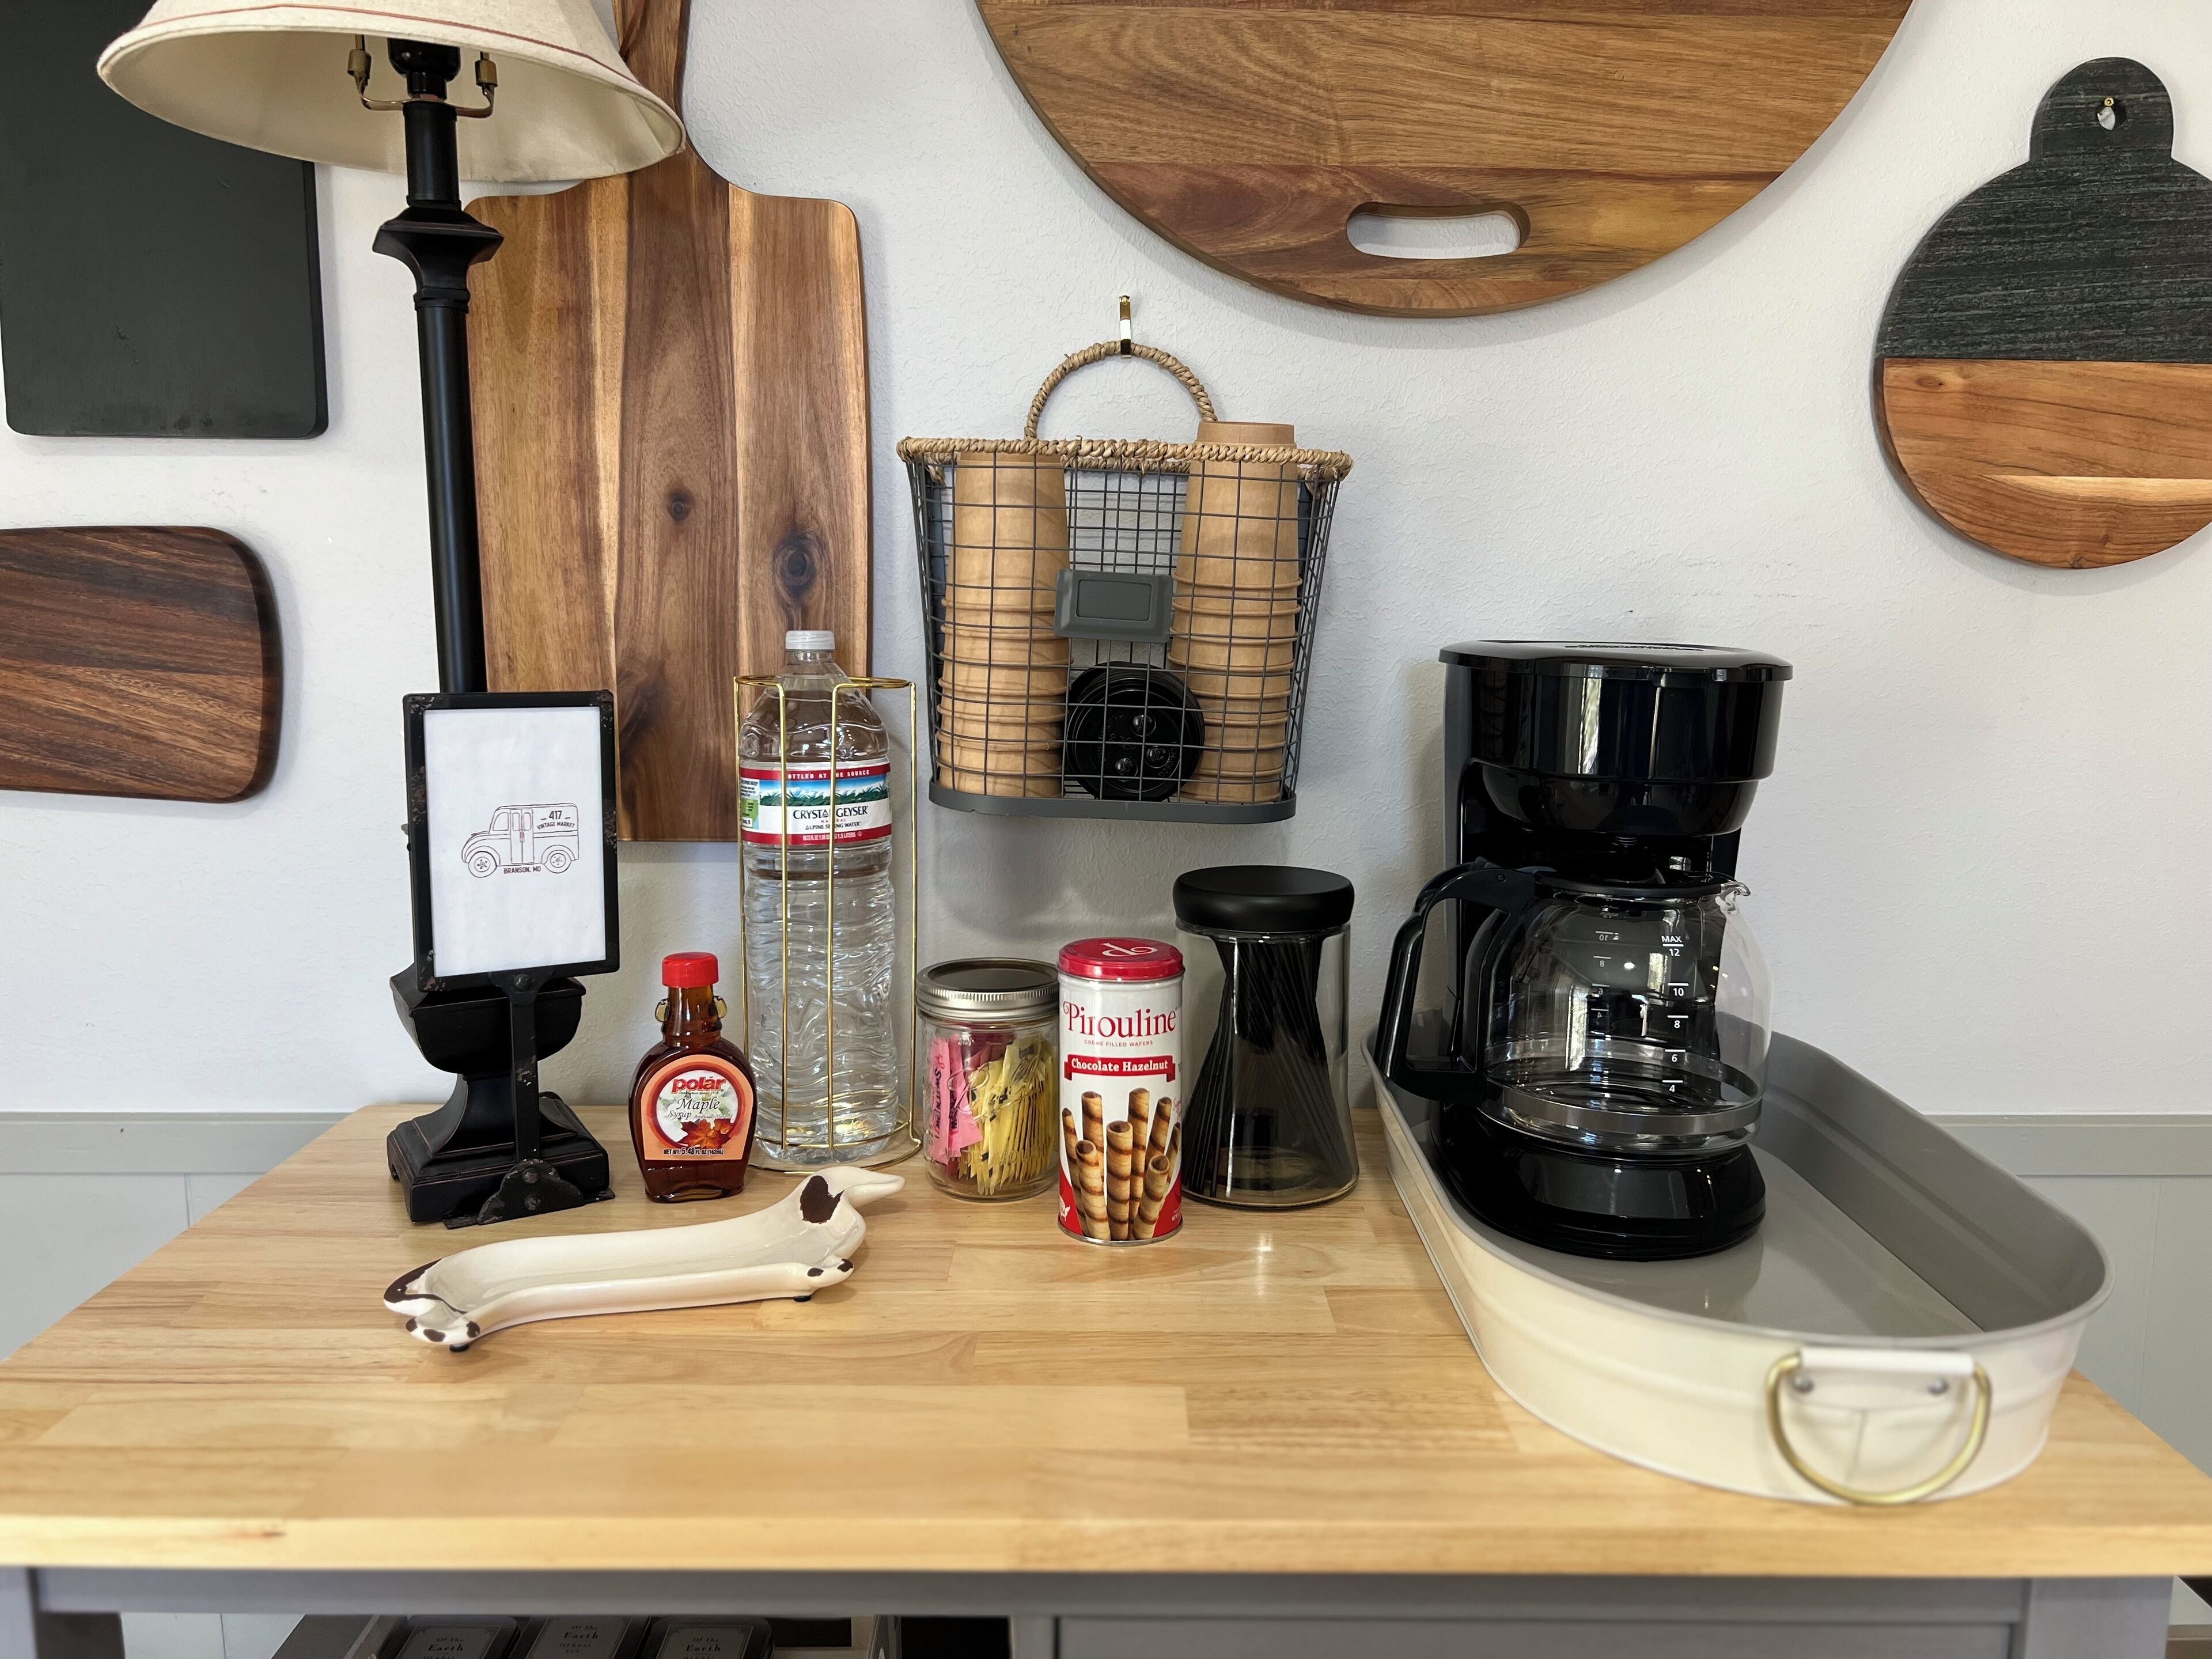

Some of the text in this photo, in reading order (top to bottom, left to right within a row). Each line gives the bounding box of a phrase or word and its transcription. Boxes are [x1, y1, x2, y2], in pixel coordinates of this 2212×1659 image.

[548, 810, 563, 820] 417
[793, 806, 868, 819] CRYSTA GEYSER
[536, 821, 556, 830] VINTAGE
[1669, 948, 1680, 956] 12
[1673, 987, 1684, 997] 10
[1063, 1001, 1176, 1038] Pirouline
[1674, 1020, 1680, 1029] 8
[1672, 1054, 1677, 1062] 6
[1071, 1058, 1119, 1071] Chocolate
[1122, 1060, 1168, 1071] Hazelnut
[672, 1077, 725, 1093] polar
[1669, 1085, 1676, 1093] 4
[676, 1096, 720, 1113] Maple
[668, 1110, 692, 1120] Syrup
